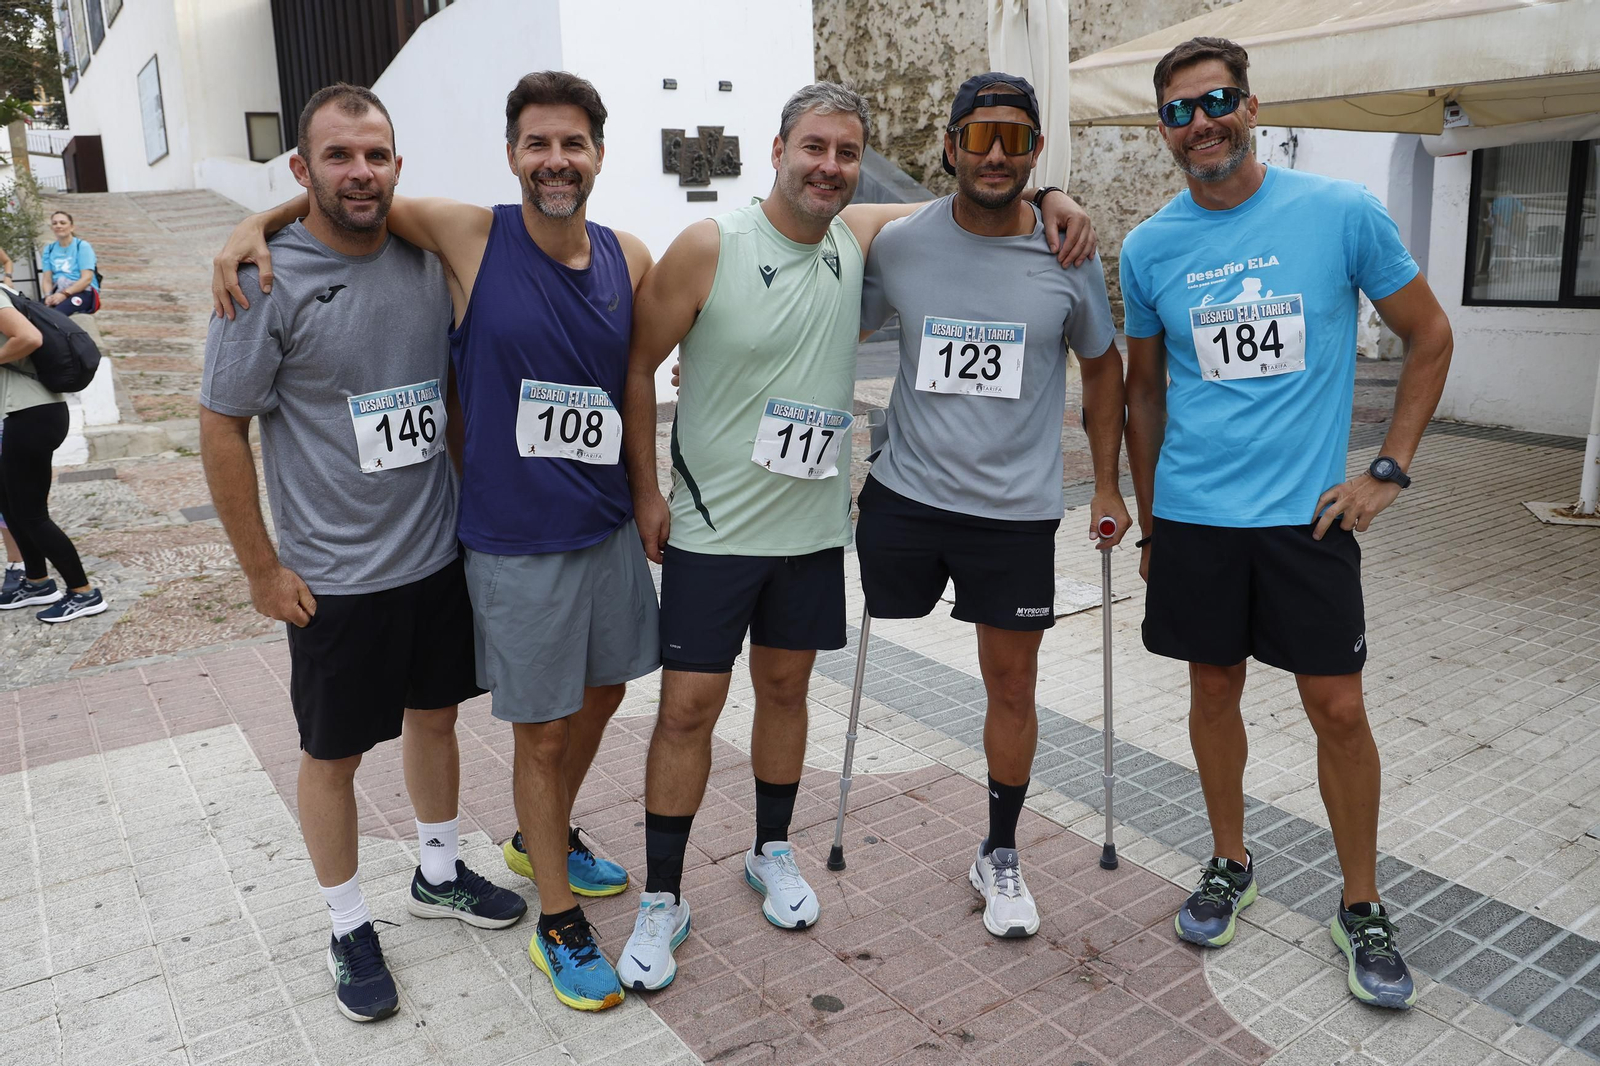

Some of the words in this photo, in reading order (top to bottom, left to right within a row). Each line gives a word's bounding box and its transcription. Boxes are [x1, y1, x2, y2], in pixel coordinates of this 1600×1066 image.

[1186, 262, 1244, 284] Desafío
[1247, 255, 1280, 270] ELA
[1200, 308, 1235, 325] DESAFÍO
[1236, 303, 1260, 323] ELA
[1261, 302, 1292, 317] TARIFA
[931, 323, 963, 338] DESAFÍO
[964, 325, 985, 342] ELA
[987, 328, 1015, 341] TARIFA
[1212, 319, 1284, 364] 184
[938, 341, 1001, 380] 123
[359, 394, 395, 414] DESAFÍO
[395, 389, 417, 410] ELA
[530, 387, 565, 403] DESAFÍO
[567, 390, 589, 409] ELA
[375, 405, 436, 452] 146
[538, 405, 603, 448] 108
[772, 403, 806, 421] DESAFÍO
[806, 408, 826, 428] ELA
[777, 423, 834, 465] 117
